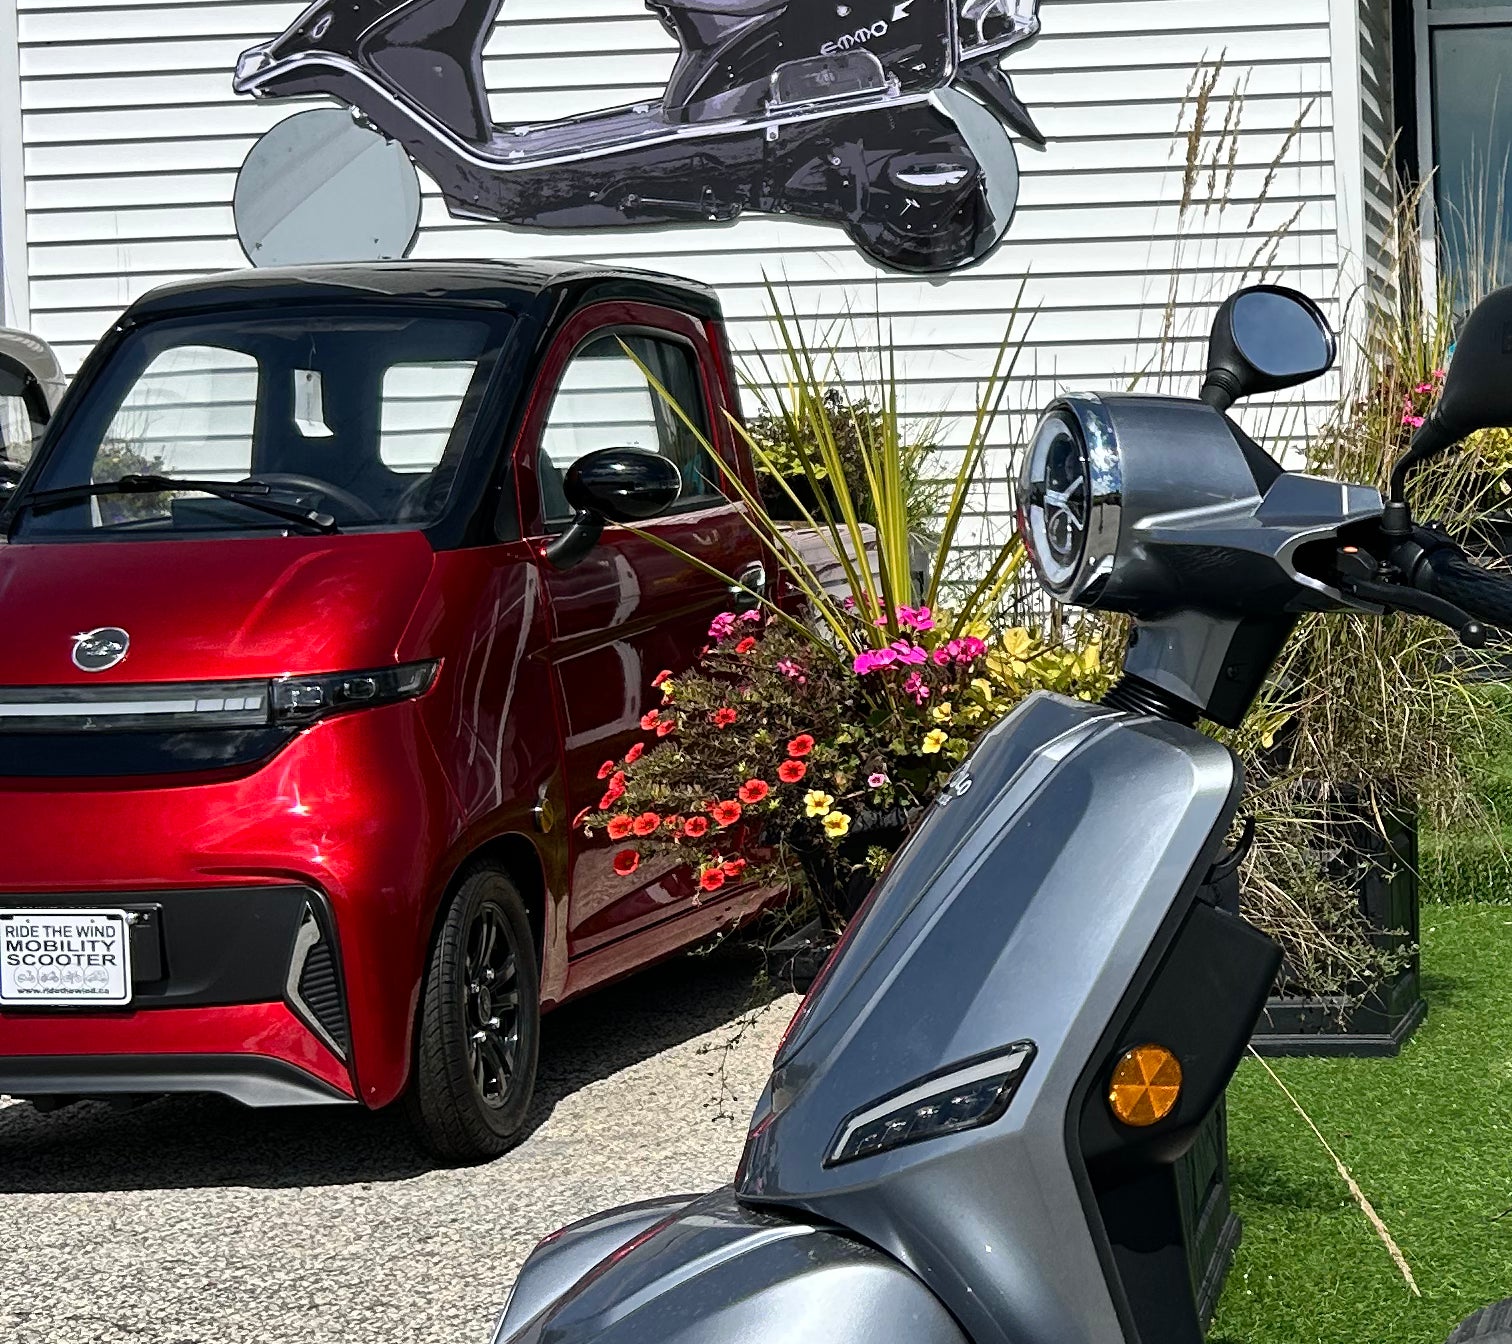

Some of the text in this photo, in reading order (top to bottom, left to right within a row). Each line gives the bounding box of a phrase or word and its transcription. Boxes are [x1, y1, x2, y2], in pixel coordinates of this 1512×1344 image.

[5, 925, 116, 938] RIDE THE WIND
[6, 940, 116, 952] MOBILITY
[7, 954, 117, 966] SCOOTER
